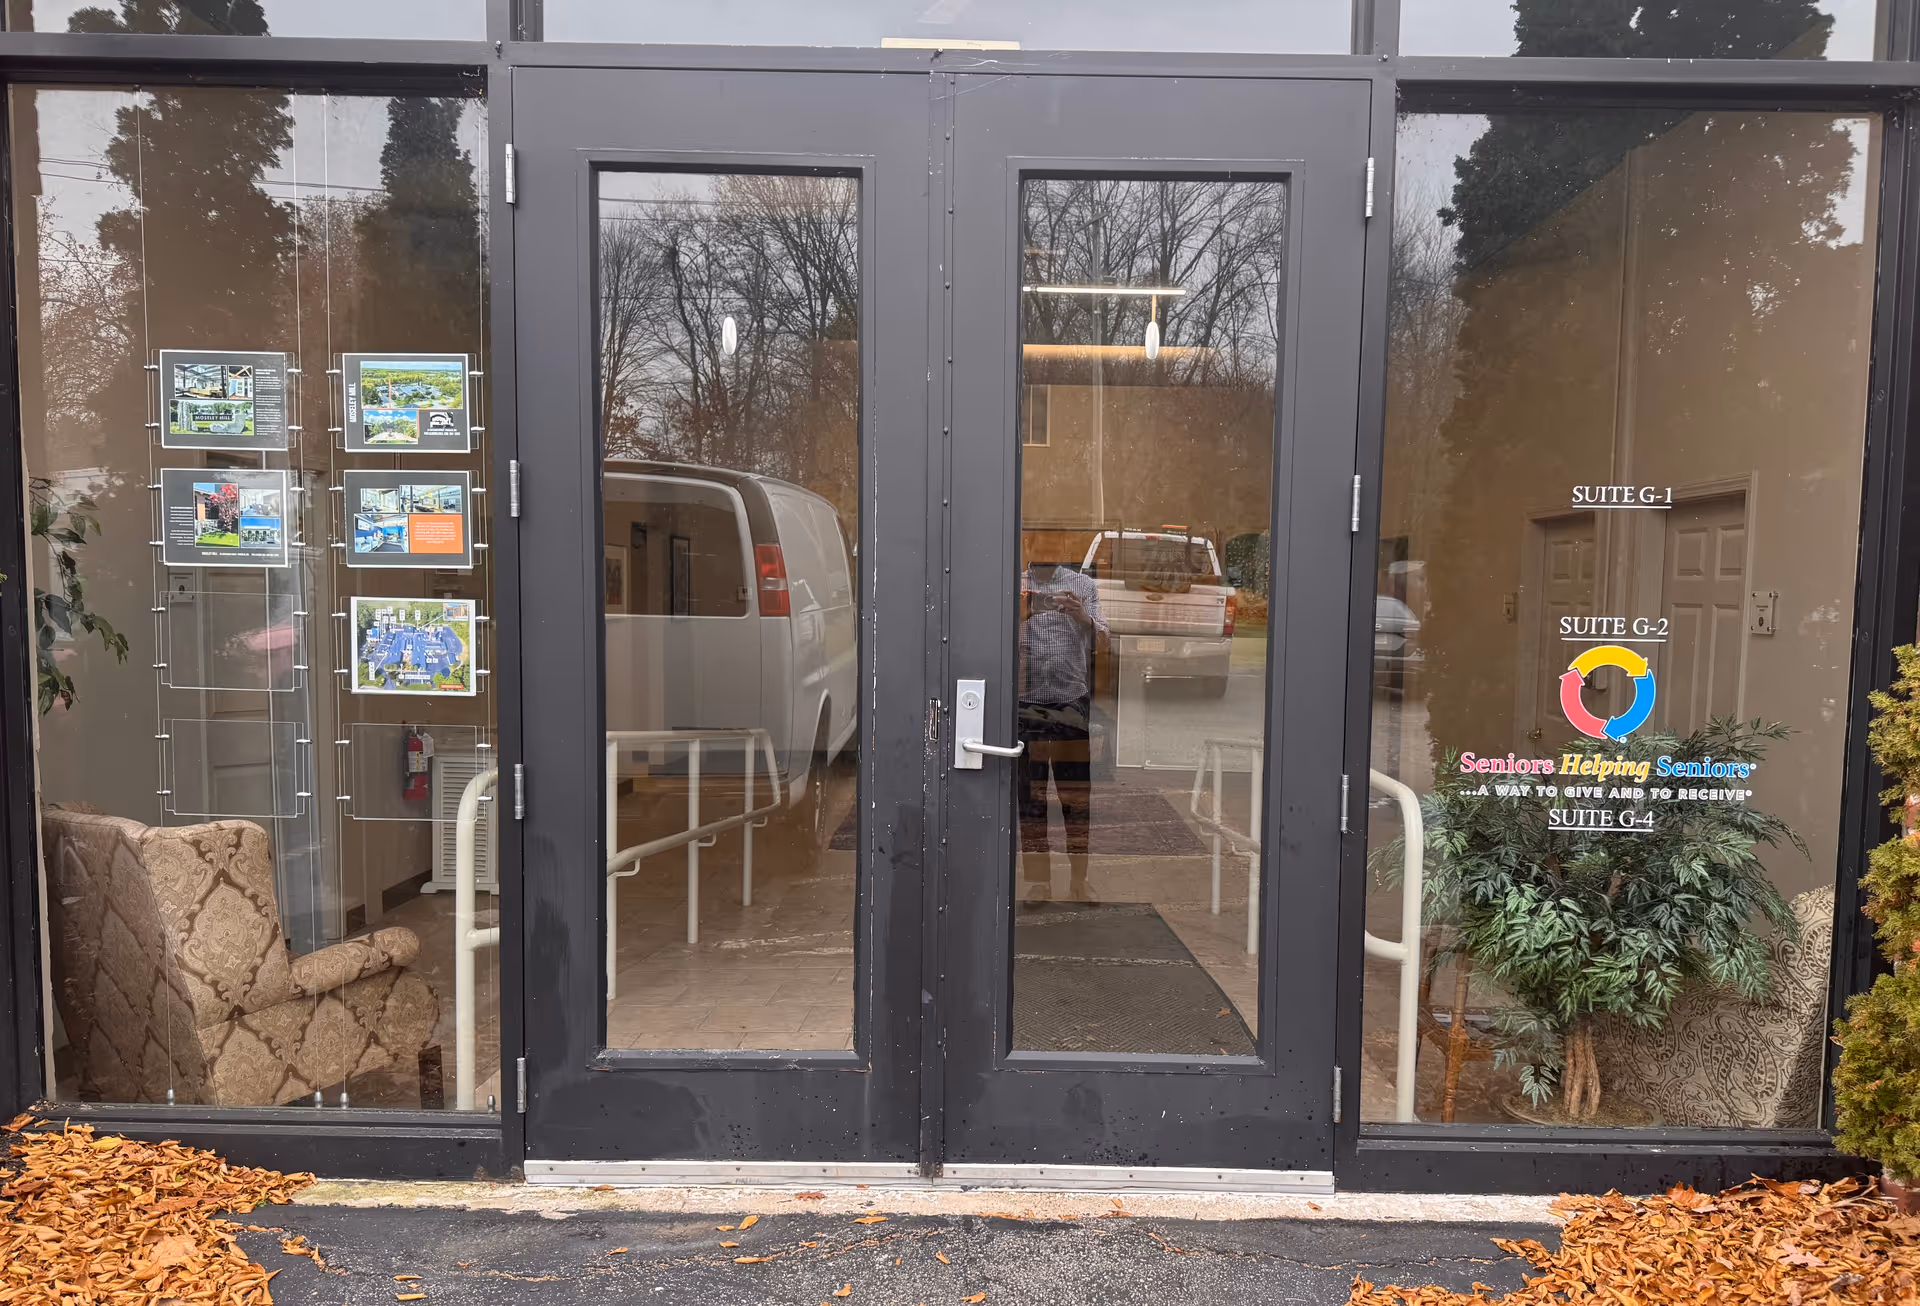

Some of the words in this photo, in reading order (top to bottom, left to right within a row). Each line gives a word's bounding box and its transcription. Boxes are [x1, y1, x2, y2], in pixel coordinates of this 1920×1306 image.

[1572, 485, 1635, 503] SUITE
[1639, 486, 1673, 504] G-1
[1559, 616, 1626, 635] SUITE
[1632, 617, 1669, 636] G-2
[1459, 751, 1555, 775] Seniors
[1558, 753, 1651, 783] Helping
[1495, 785, 1532, 797] WAY
[1536, 785, 1558, 798] TO
[1564, 786, 1603, 798] GIVE
[1608, 787, 1644, 799] AND
[1650, 788, 1672, 800] TO
[1548, 808, 1613, 827] SUITE
[1619, 810, 1655, 828] G-4
